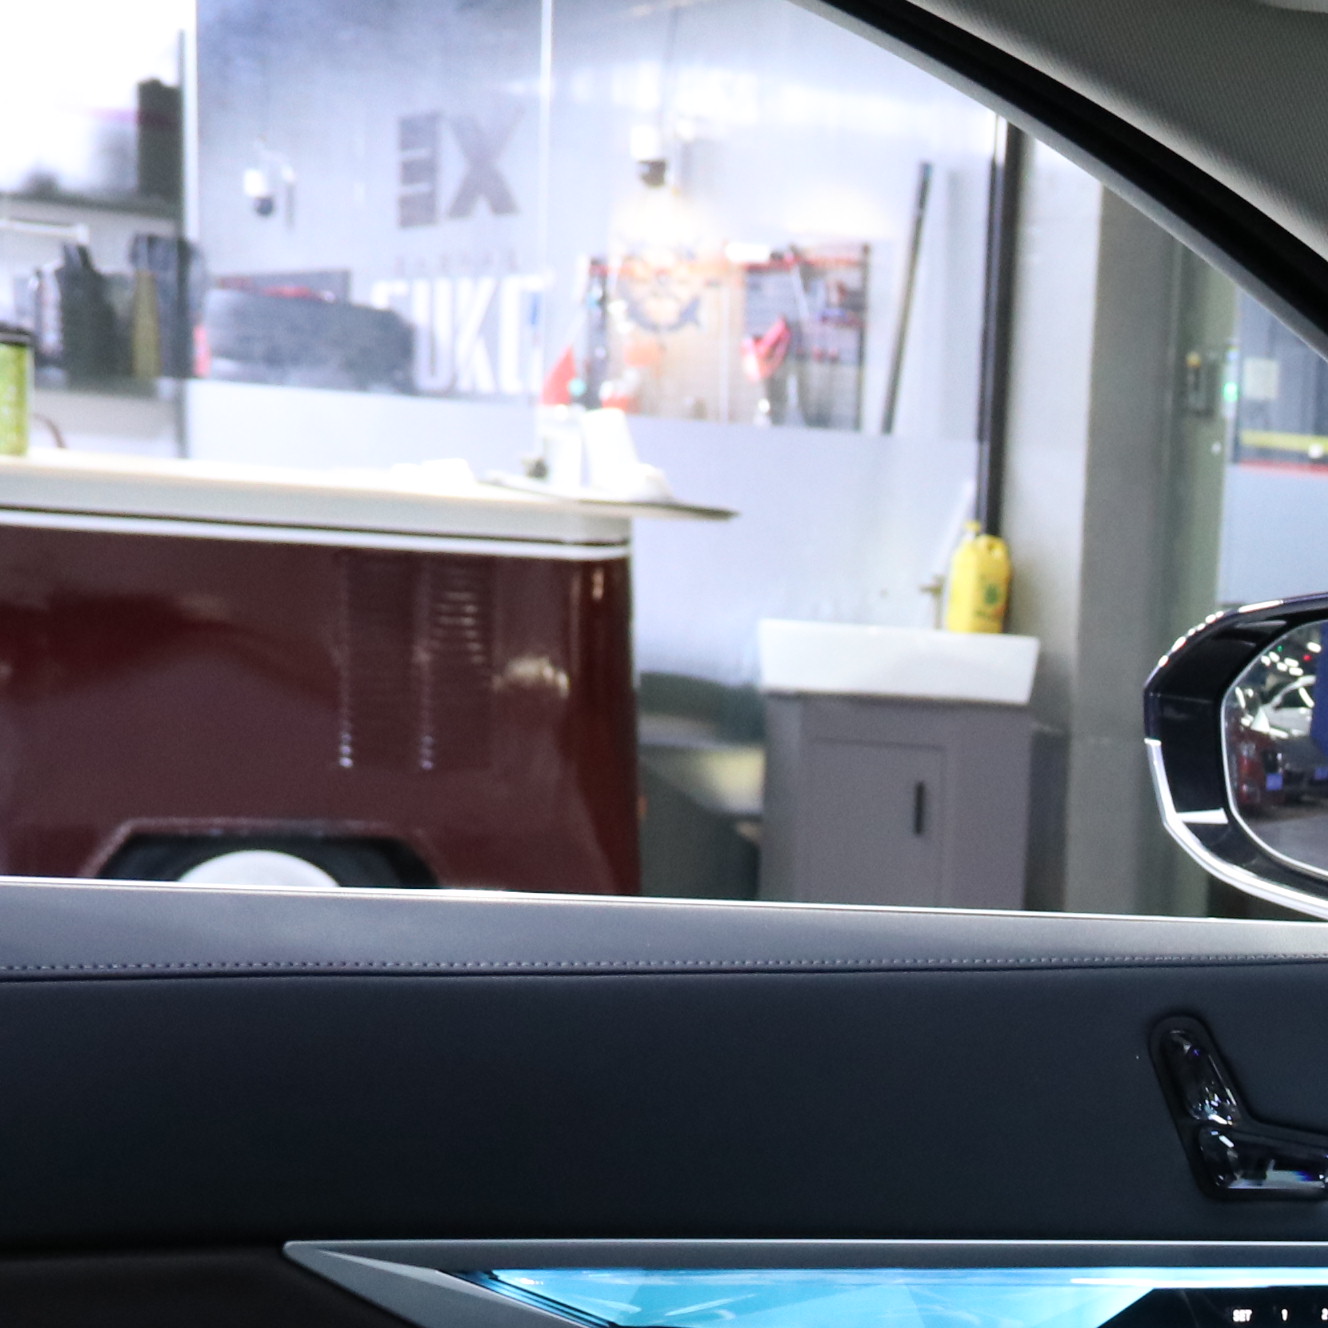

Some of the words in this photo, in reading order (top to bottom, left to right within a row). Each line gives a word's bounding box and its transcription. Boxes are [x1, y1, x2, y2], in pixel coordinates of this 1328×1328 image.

[1232, 1309, 1252, 1322] SET
[1281, 1308, 1288, 1321] 1
[1321, 1308, 1328, 1321] 2
